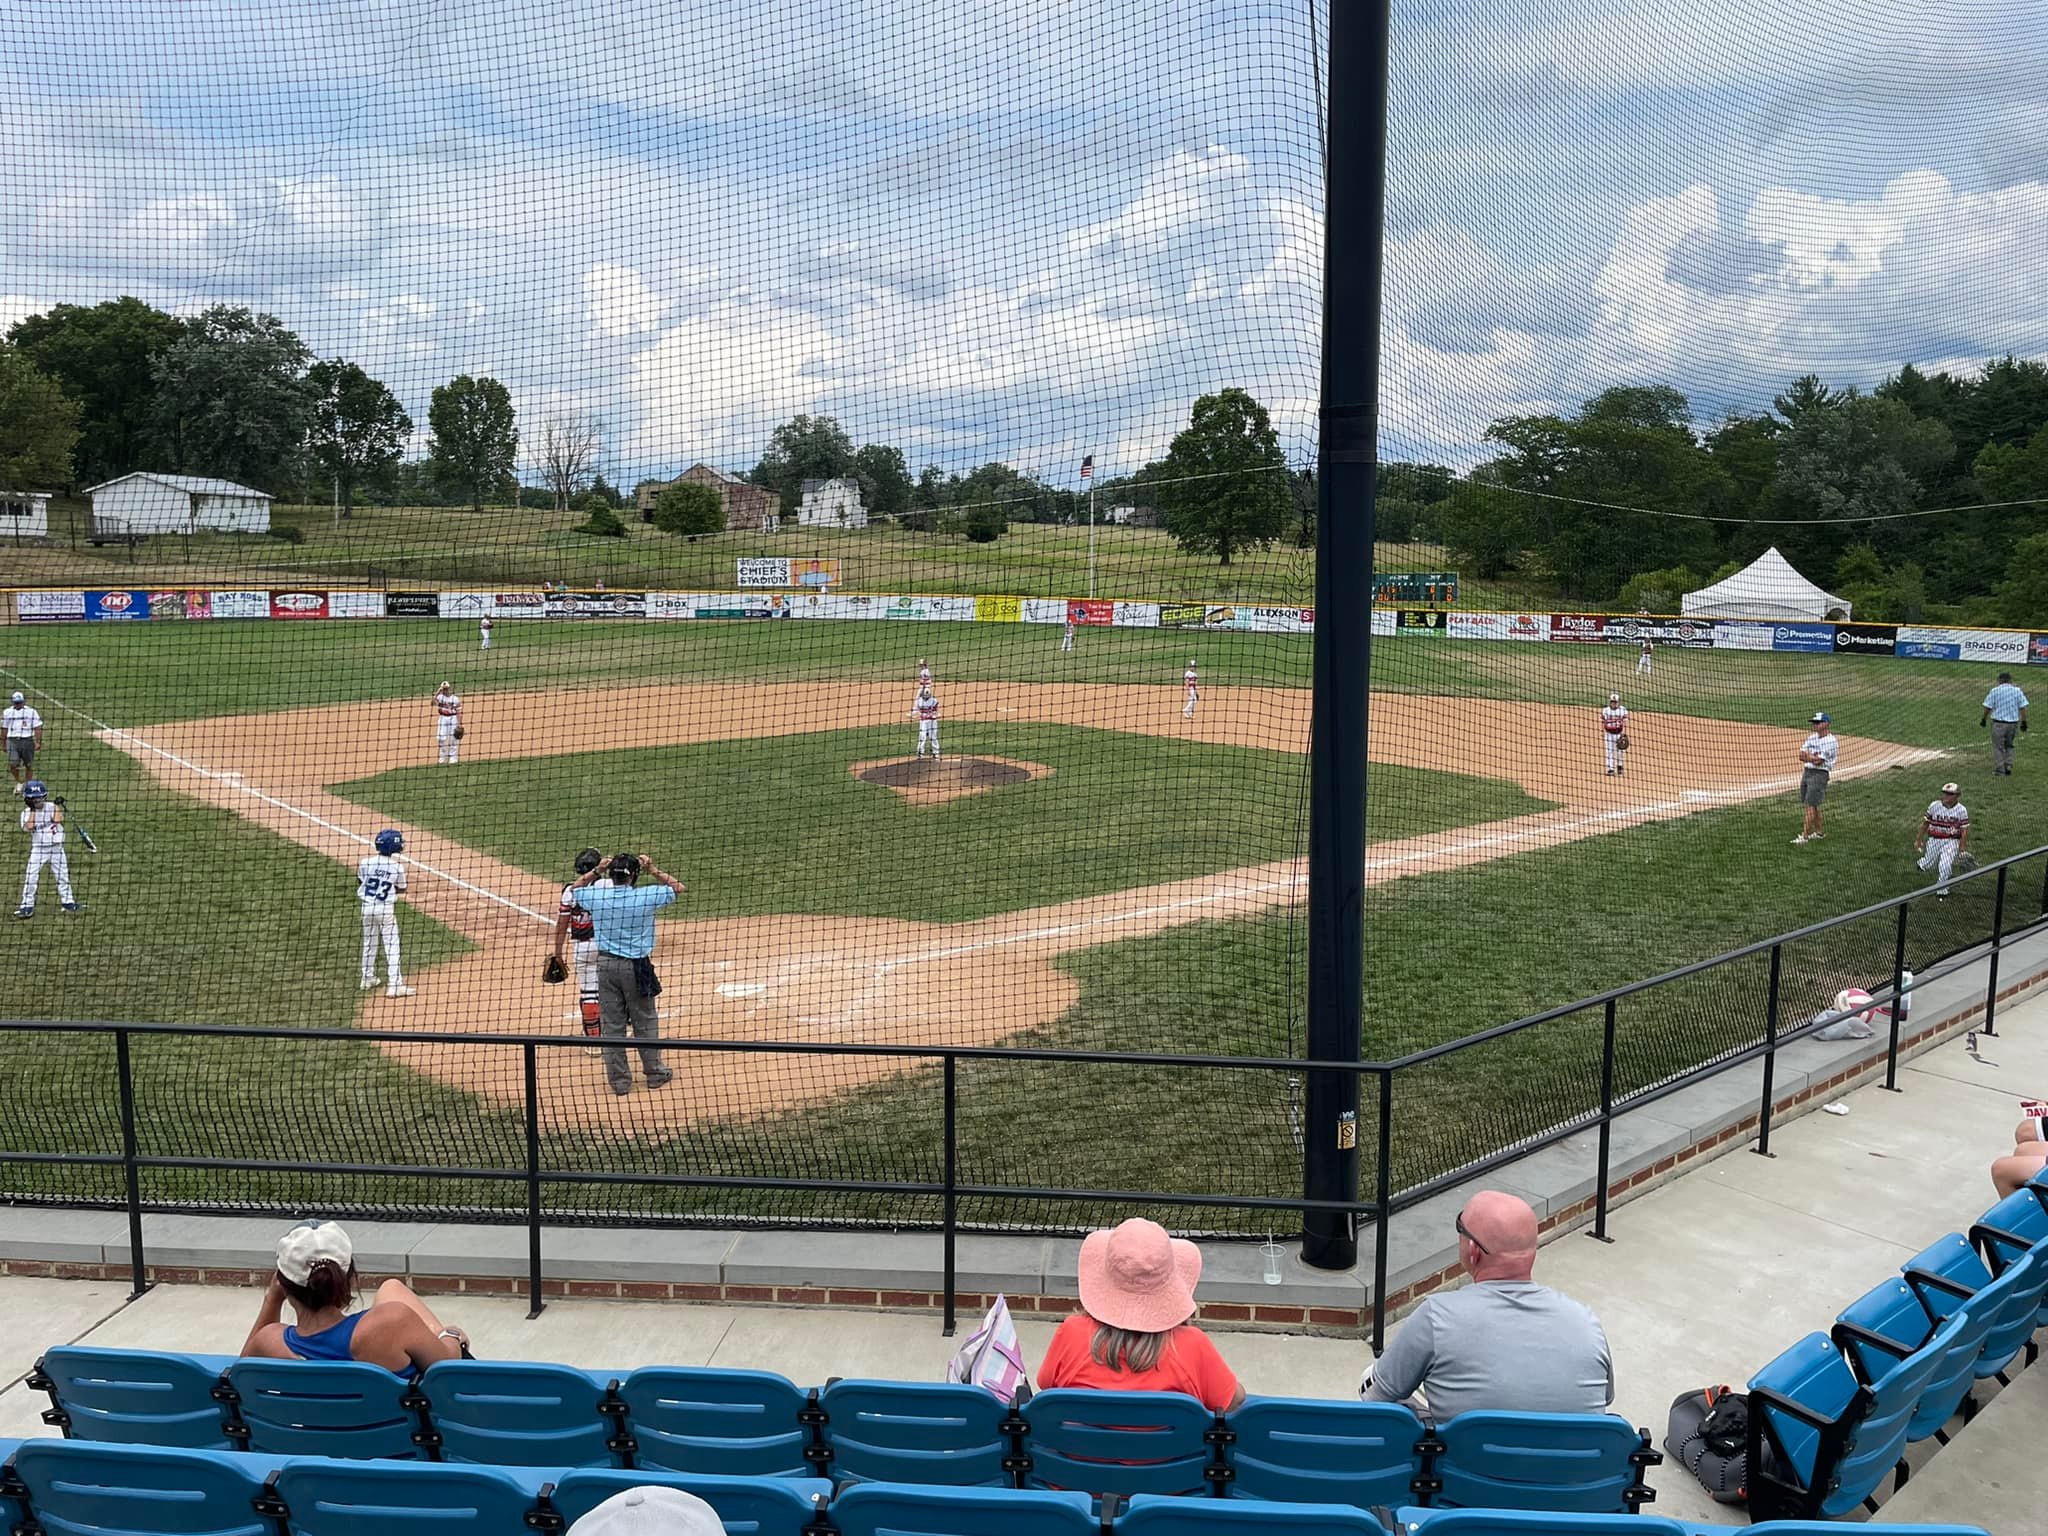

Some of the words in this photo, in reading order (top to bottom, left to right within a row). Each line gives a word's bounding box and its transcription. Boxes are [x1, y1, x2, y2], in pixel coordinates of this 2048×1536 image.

[740, 559, 776, 567] WELCOME
[777, 559, 787, 567] TO
[740, 566, 787, 576] CHIEF'S
[740, 576, 788, 584] STADIUM
[1162, 606, 1205, 621] EDGE
[1253, 607, 1299, 618] ALEXSON
[1851, 635, 1895, 647] Marketing
[1965, 641, 2025, 652] BRADFORD
[364, 877, 393, 901] 23
